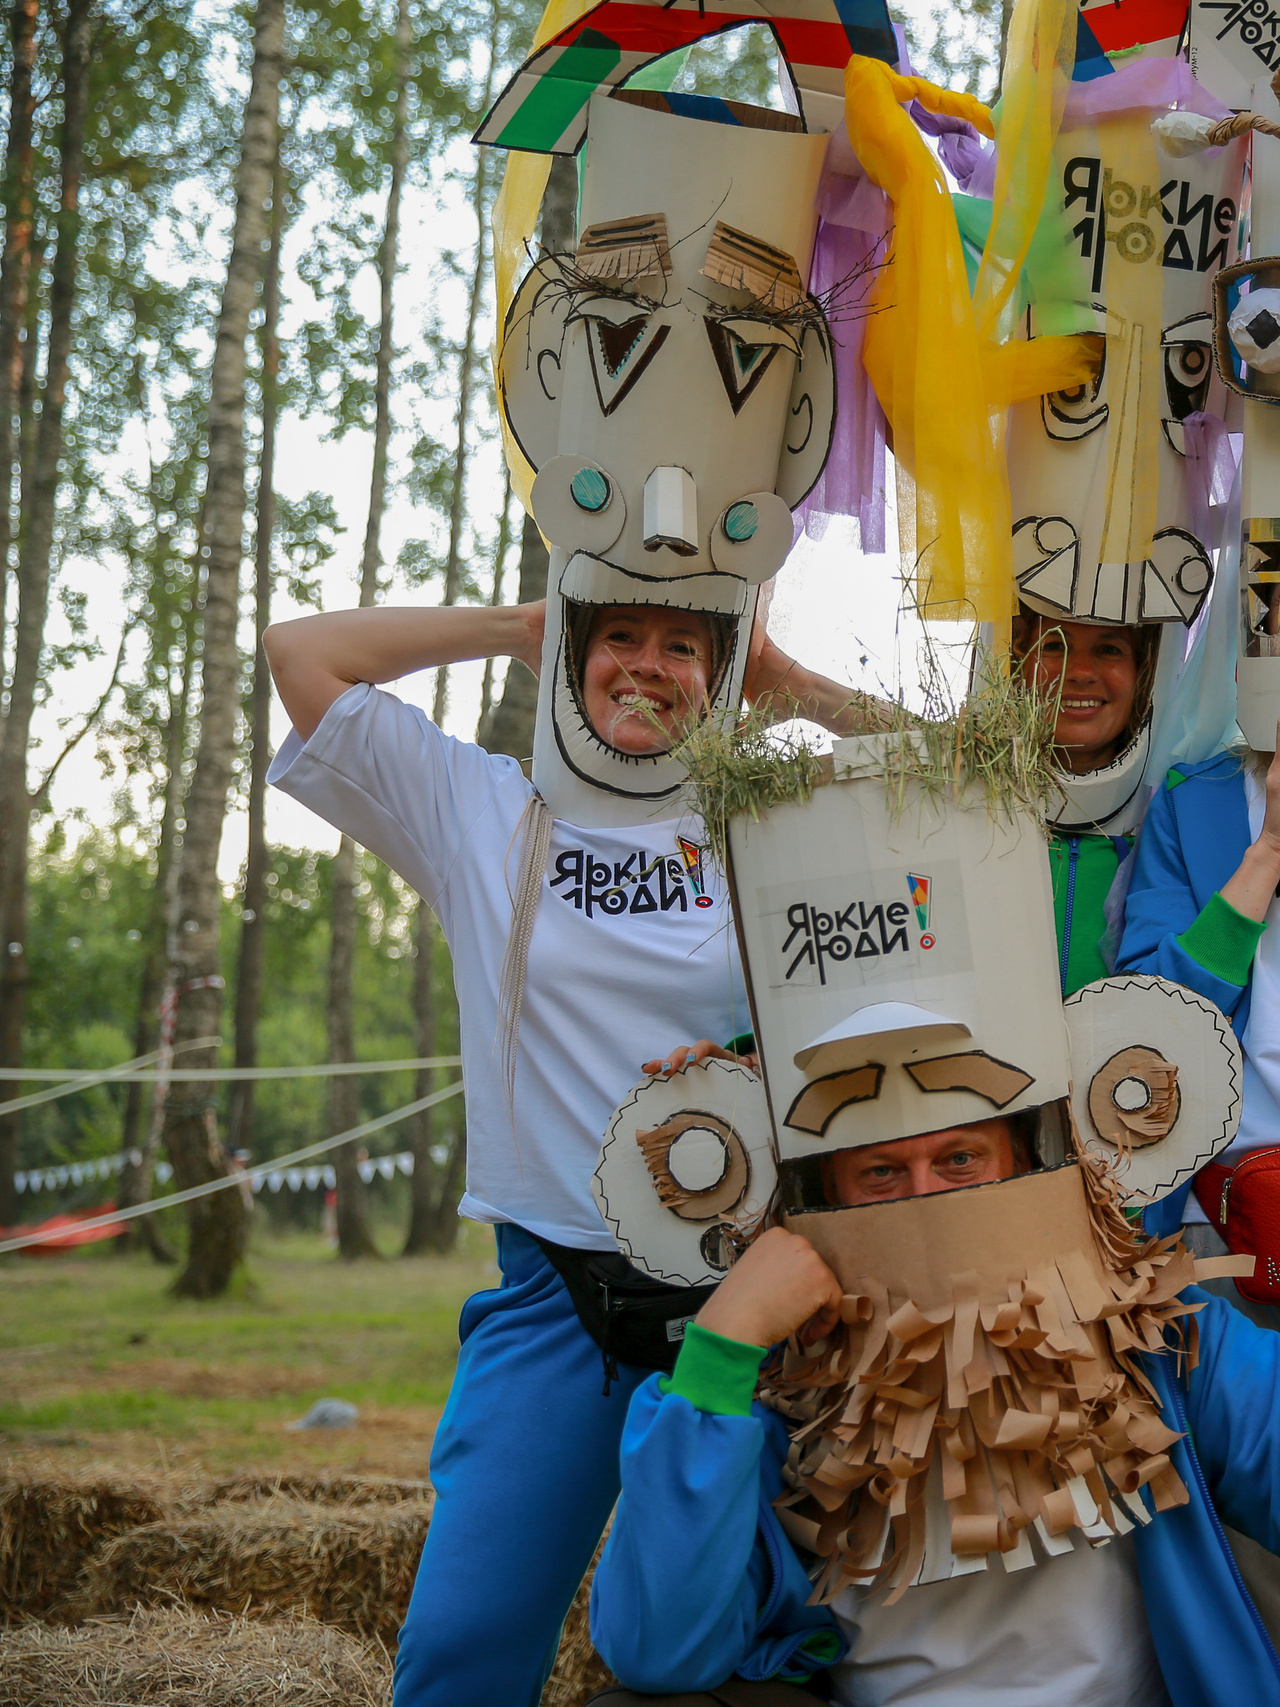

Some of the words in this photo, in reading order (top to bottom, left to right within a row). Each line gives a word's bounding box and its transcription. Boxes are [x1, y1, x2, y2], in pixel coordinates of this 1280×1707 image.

[1059, 156, 1237, 235] Яркие
[549, 849, 684, 887] Яркие
[781, 900, 910, 953] Яркие
